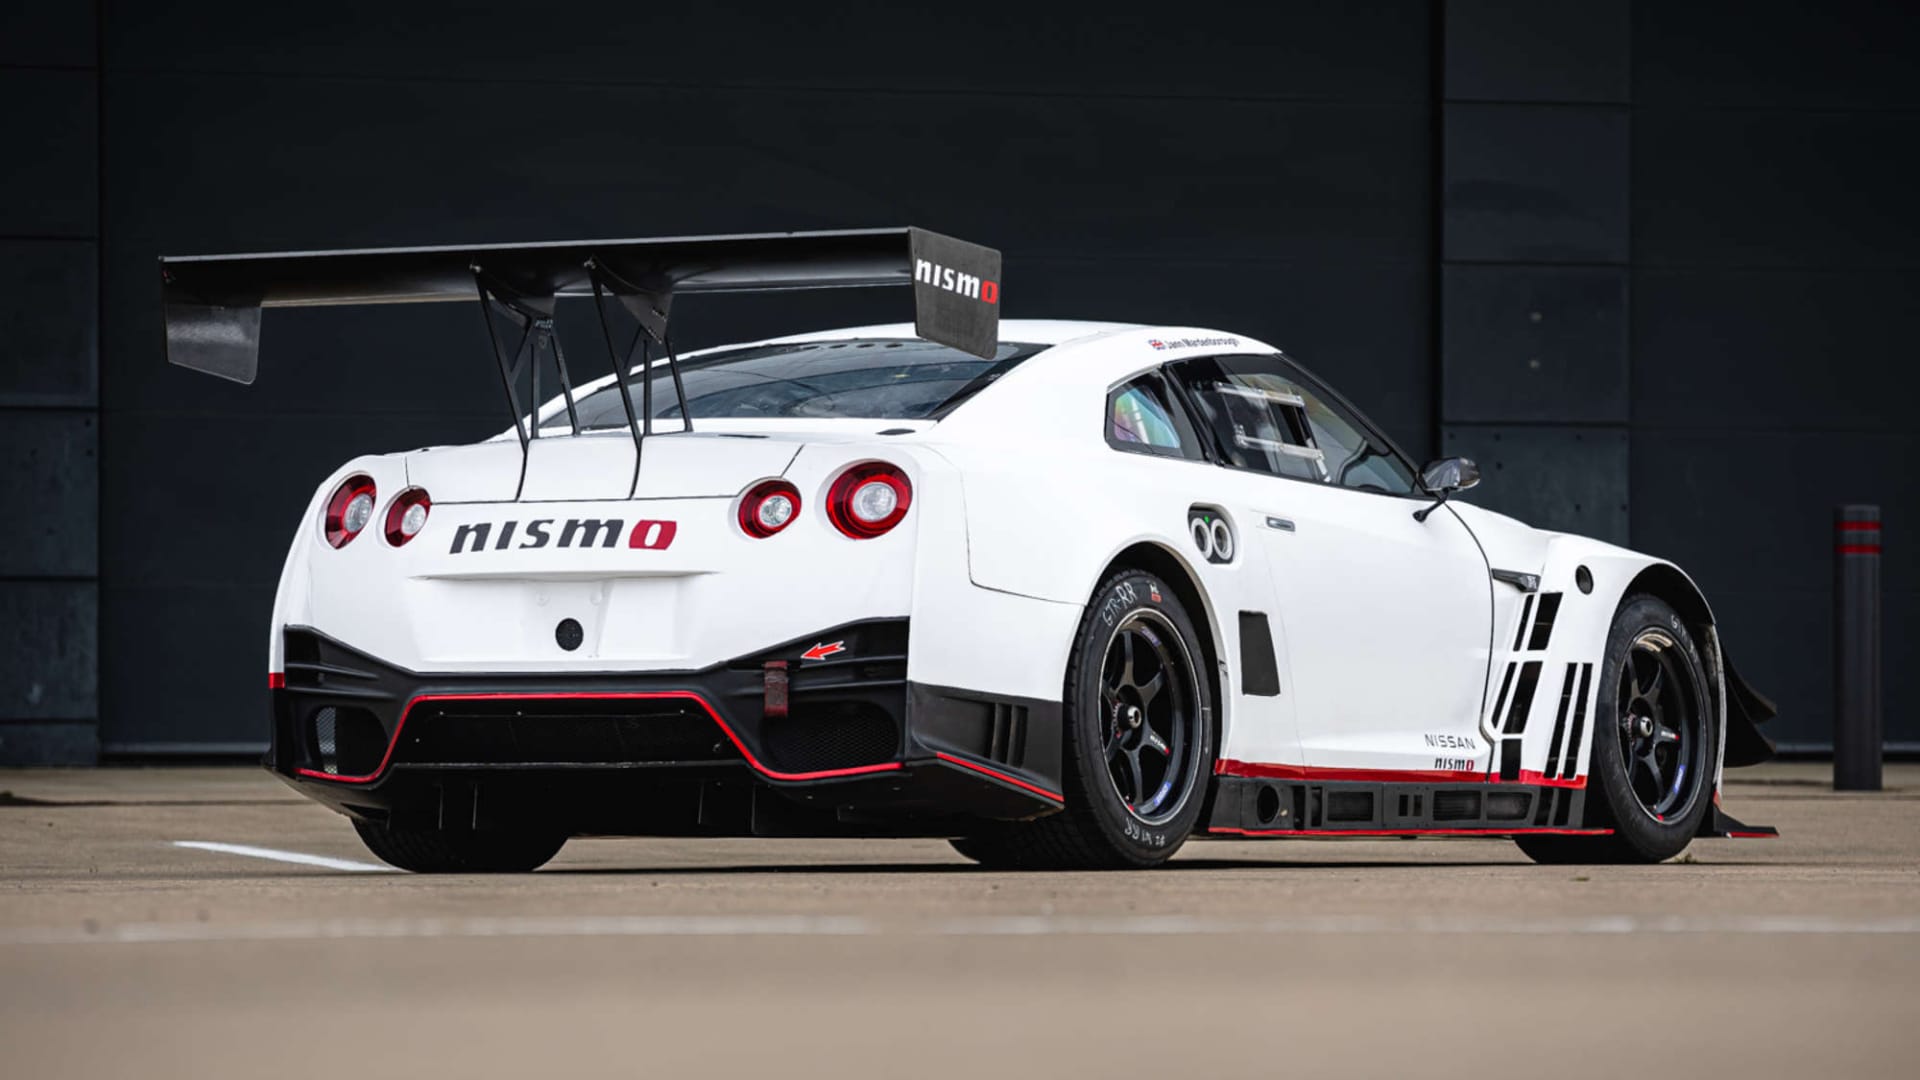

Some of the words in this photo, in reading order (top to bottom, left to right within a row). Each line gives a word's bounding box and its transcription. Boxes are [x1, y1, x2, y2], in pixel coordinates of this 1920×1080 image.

[915, 258, 999, 305] nismo
[449, 518, 678, 555] nismo
[1425, 733, 1476, 750] NISSAN
[1434, 757, 1475, 771] nismo
